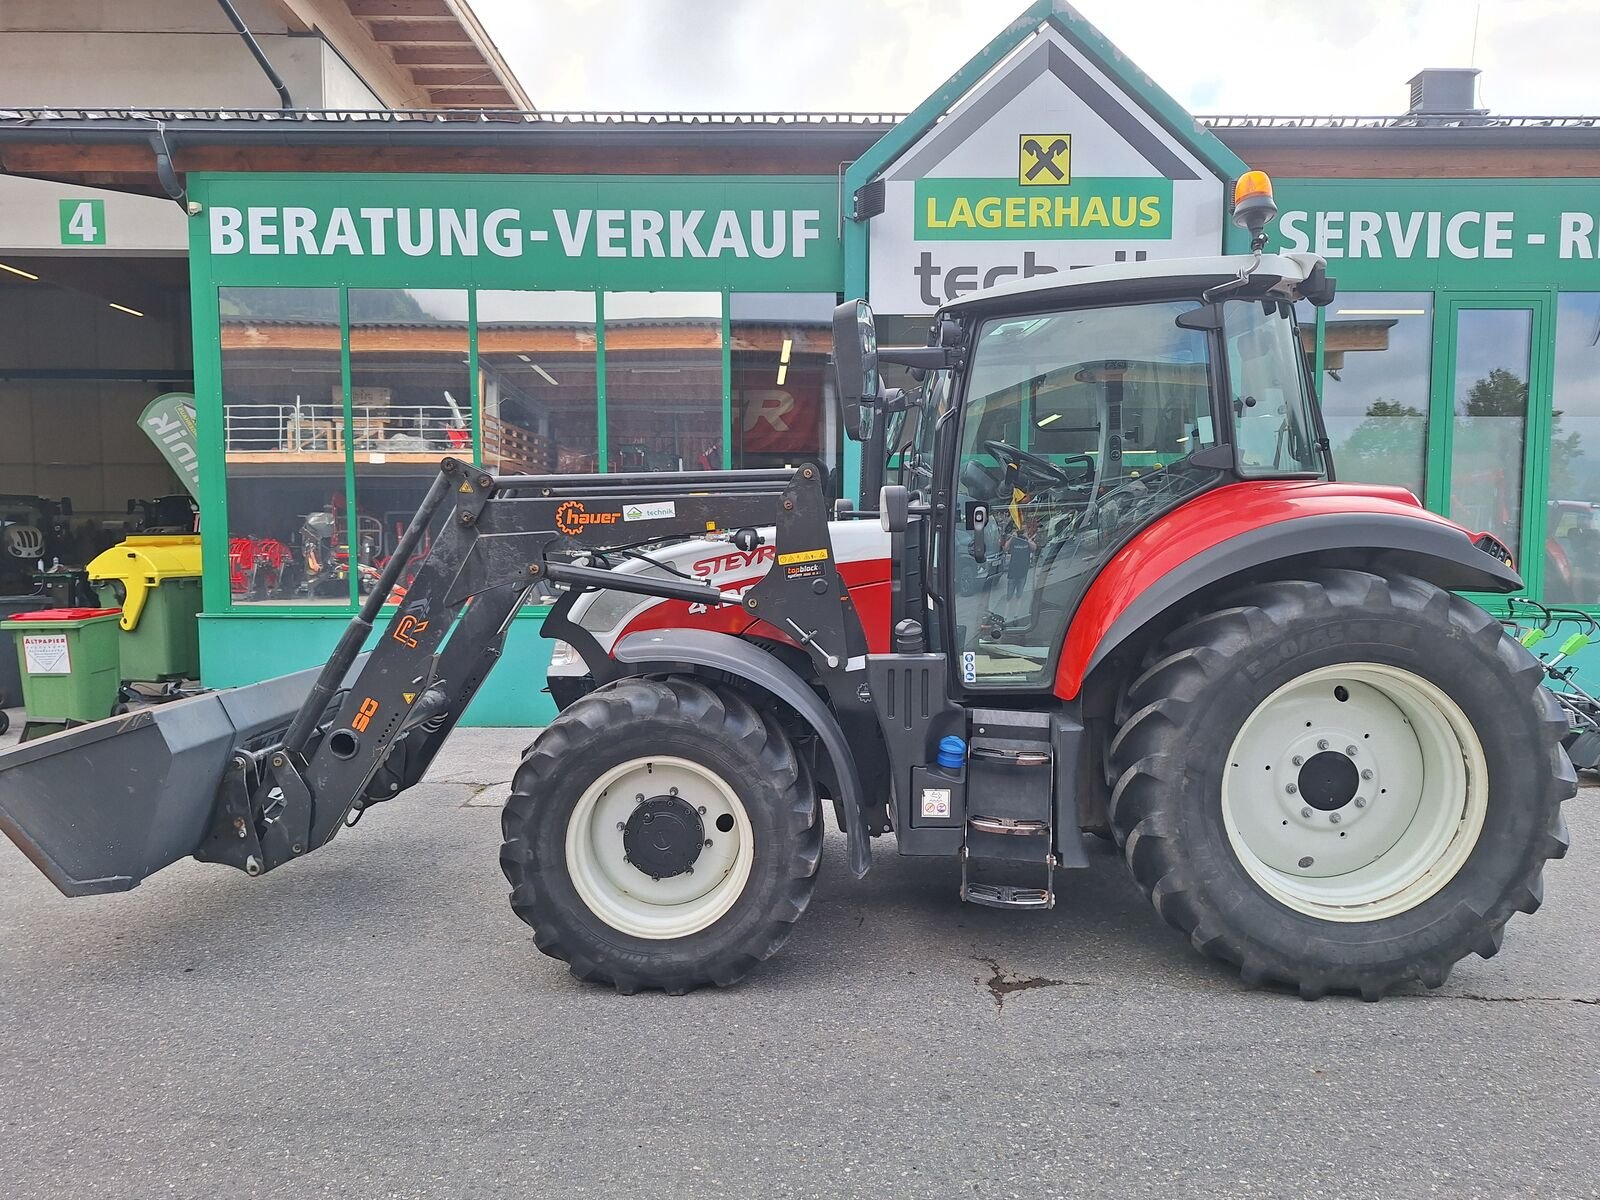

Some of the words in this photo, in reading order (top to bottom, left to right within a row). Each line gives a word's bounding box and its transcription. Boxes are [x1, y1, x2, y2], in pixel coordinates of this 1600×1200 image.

[69, 203, 97, 241] 4
[927, 196, 1161, 229] LAGERHAUS
[1279, 210, 1514, 259] SERVICE
[1560, 212, 1600, 259] R
[566, 508, 622, 525] hauer
[646, 509, 674, 517] technik
[693, 545, 776, 577] STEYR
